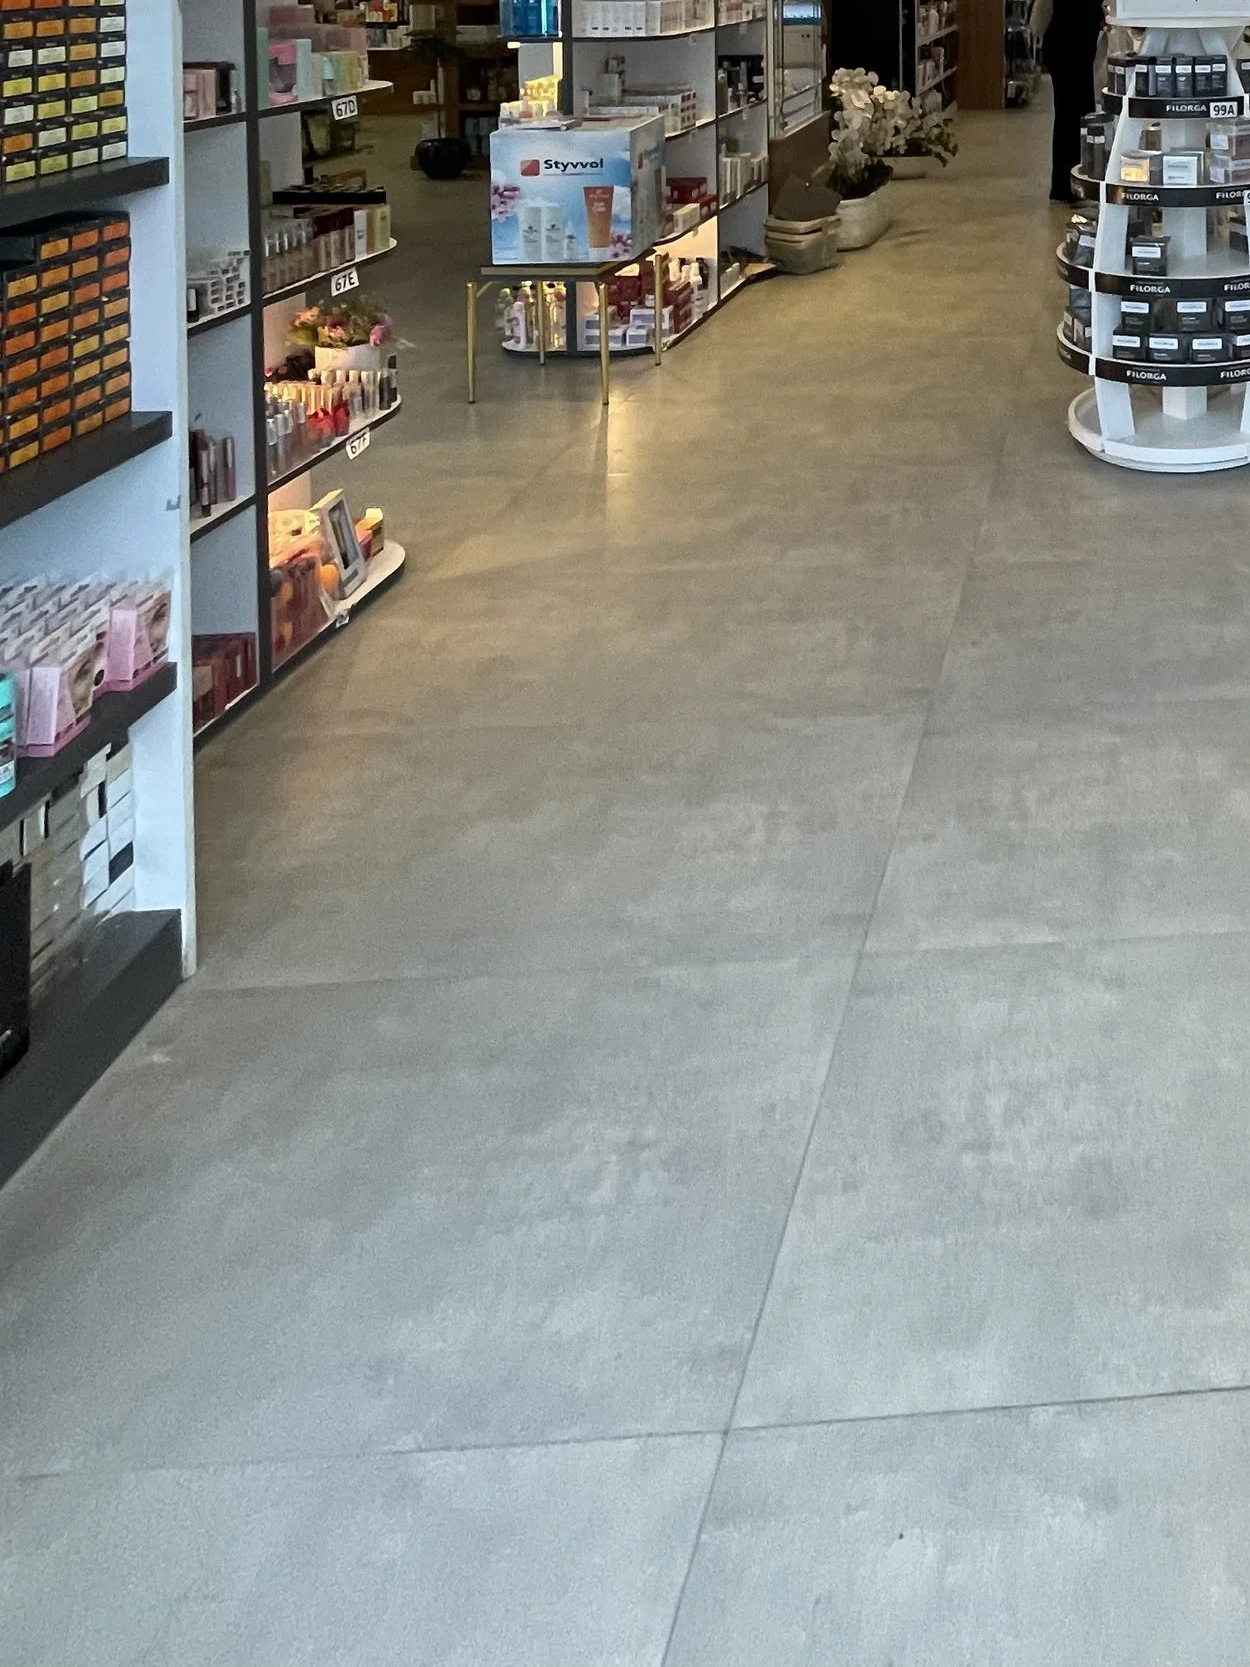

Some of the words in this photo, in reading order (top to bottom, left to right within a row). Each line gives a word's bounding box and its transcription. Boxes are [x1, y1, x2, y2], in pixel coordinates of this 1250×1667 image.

[336, 100, 356, 118] 67D
[1165, 104, 1207, 112] FILORGA
[1213, 104, 1235, 116] 99A
[543, 158, 604, 172] Styvvol
[335, 272, 356, 293] 67E
[1130, 284, 1171, 294] FILORGA
[1126, 370, 1167, 381] FILORGA
